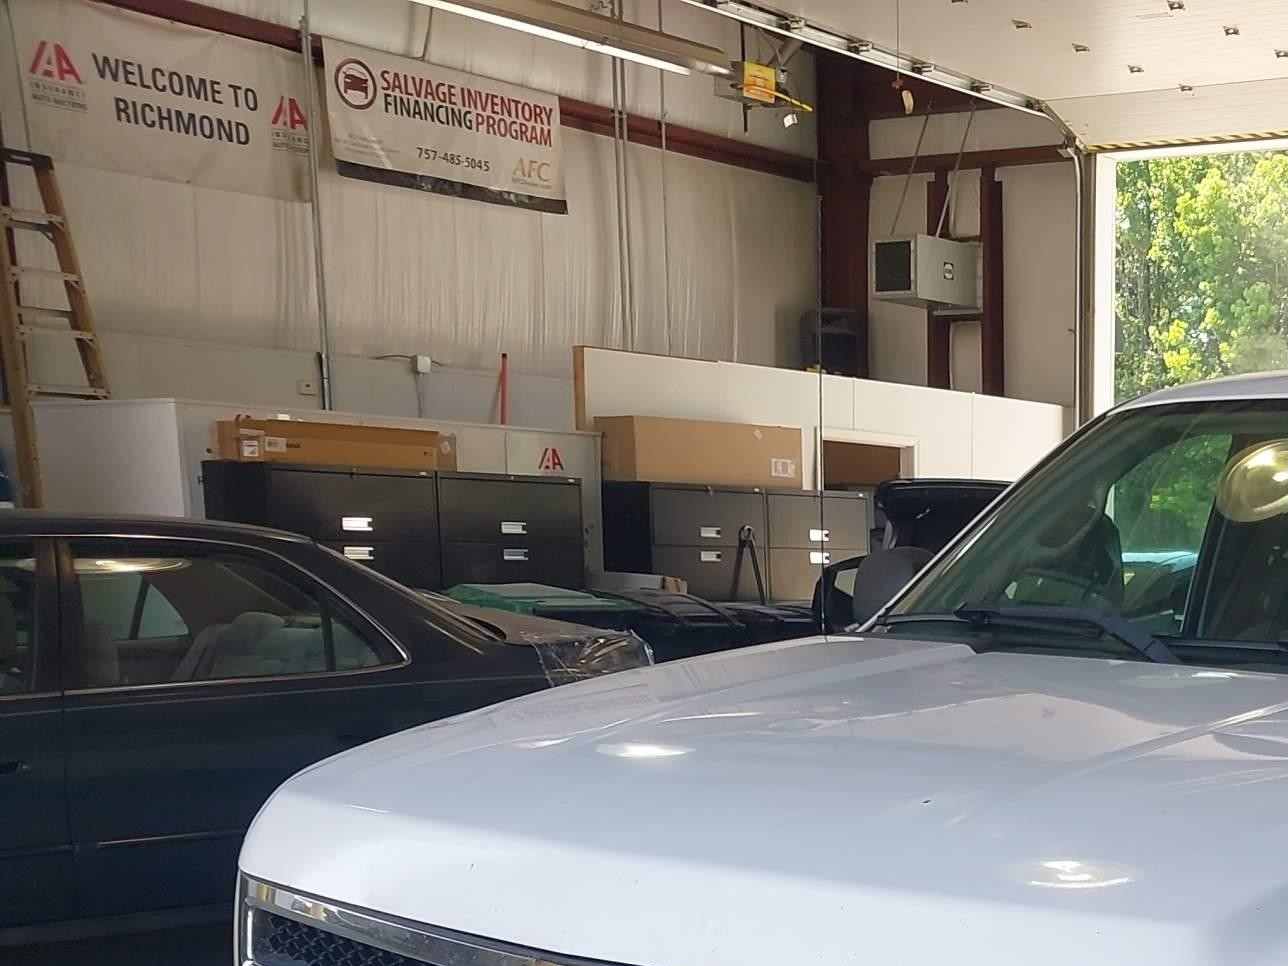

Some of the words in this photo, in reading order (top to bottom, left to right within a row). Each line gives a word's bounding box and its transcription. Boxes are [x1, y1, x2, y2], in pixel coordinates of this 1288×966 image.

[92, 53, 223, 104] WELCOME
[228, 84, 258, 111] TO
[380, 70, 457, 106] SALVAGE
[461, 87, 553, 127] INVENTORY
[114, 97, 250, 145] RICHMOND
[384, 93, 473, 130] FINANCING
[475, 112, 552, 147] PROGRAM
[416, 147, 490, 172] 757-485-5045
[512, 158, 551, 182] AFC
